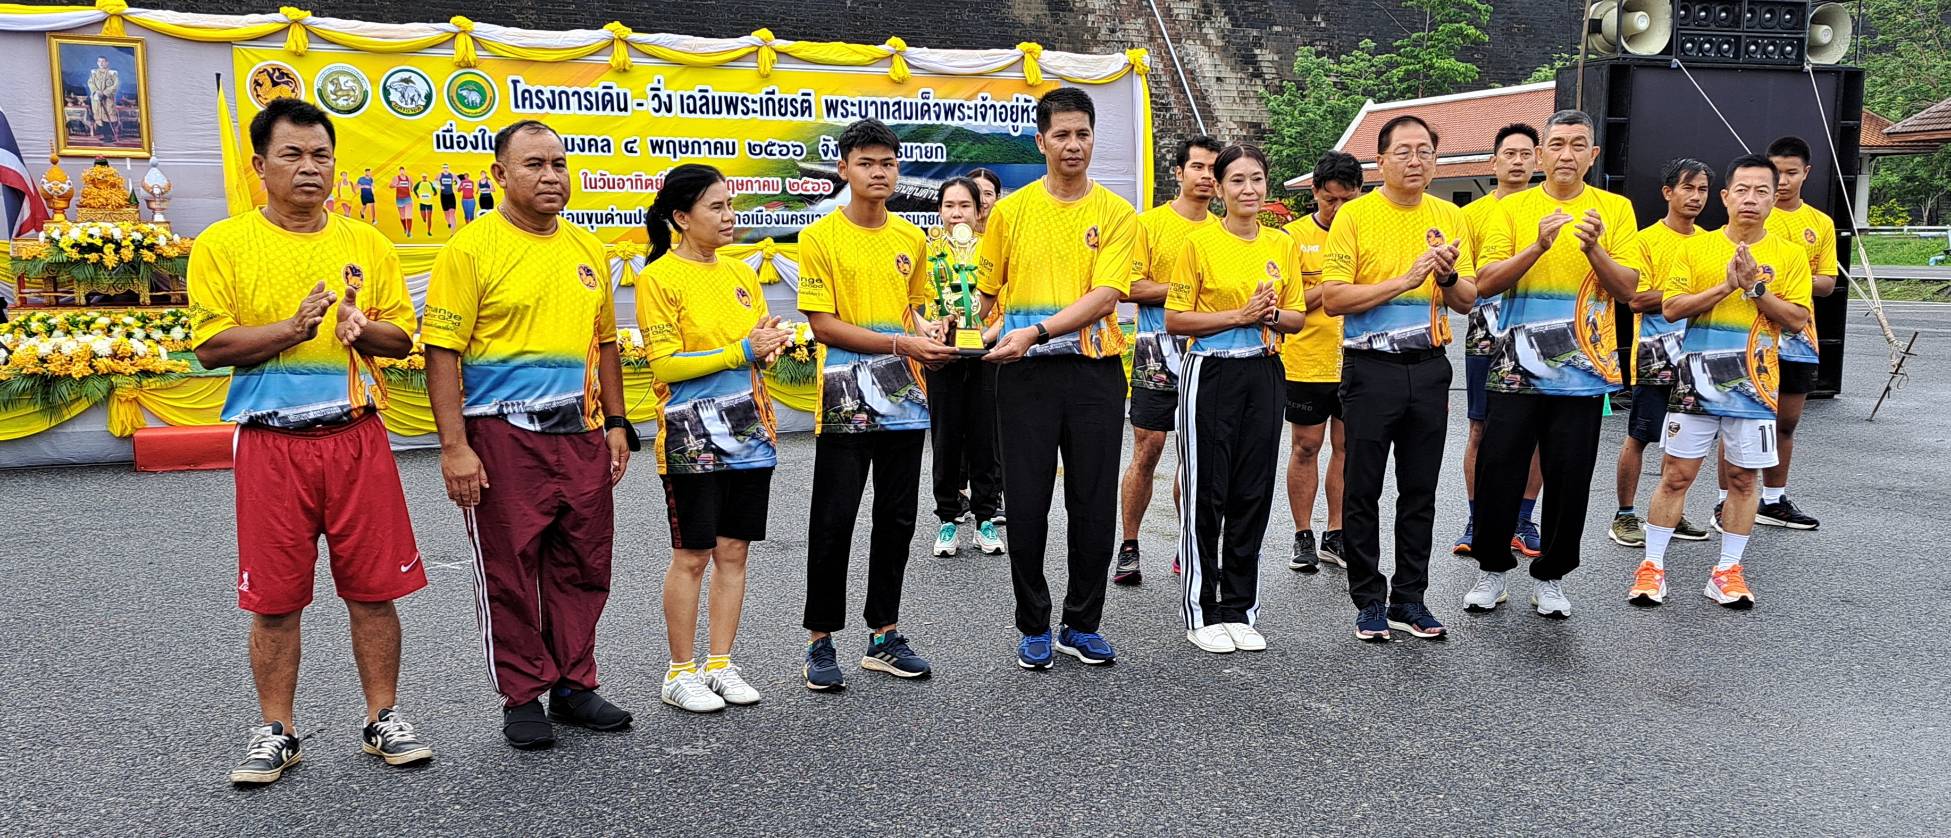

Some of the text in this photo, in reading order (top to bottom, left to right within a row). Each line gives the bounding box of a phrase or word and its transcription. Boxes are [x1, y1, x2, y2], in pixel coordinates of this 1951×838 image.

[511, 80, 628, 112] โครงการเดิน
[651, 79, 673, 114] วิ่ง
[680, 88, 813, 118] เฉลิมพระเกียรติ
[564, 136, 612, 154] มงคล
[624, 138, 638, 154] ๔
[649, 138, 736, 160] พฤษภาคม
[748, 140, 805, 158] ๒๕๖๖
[896, 143, 944, 161] รนายก
[581, 171, 832, 195] ในวันอาทิตย์ ฤษภาคม ๒๕๖๖
